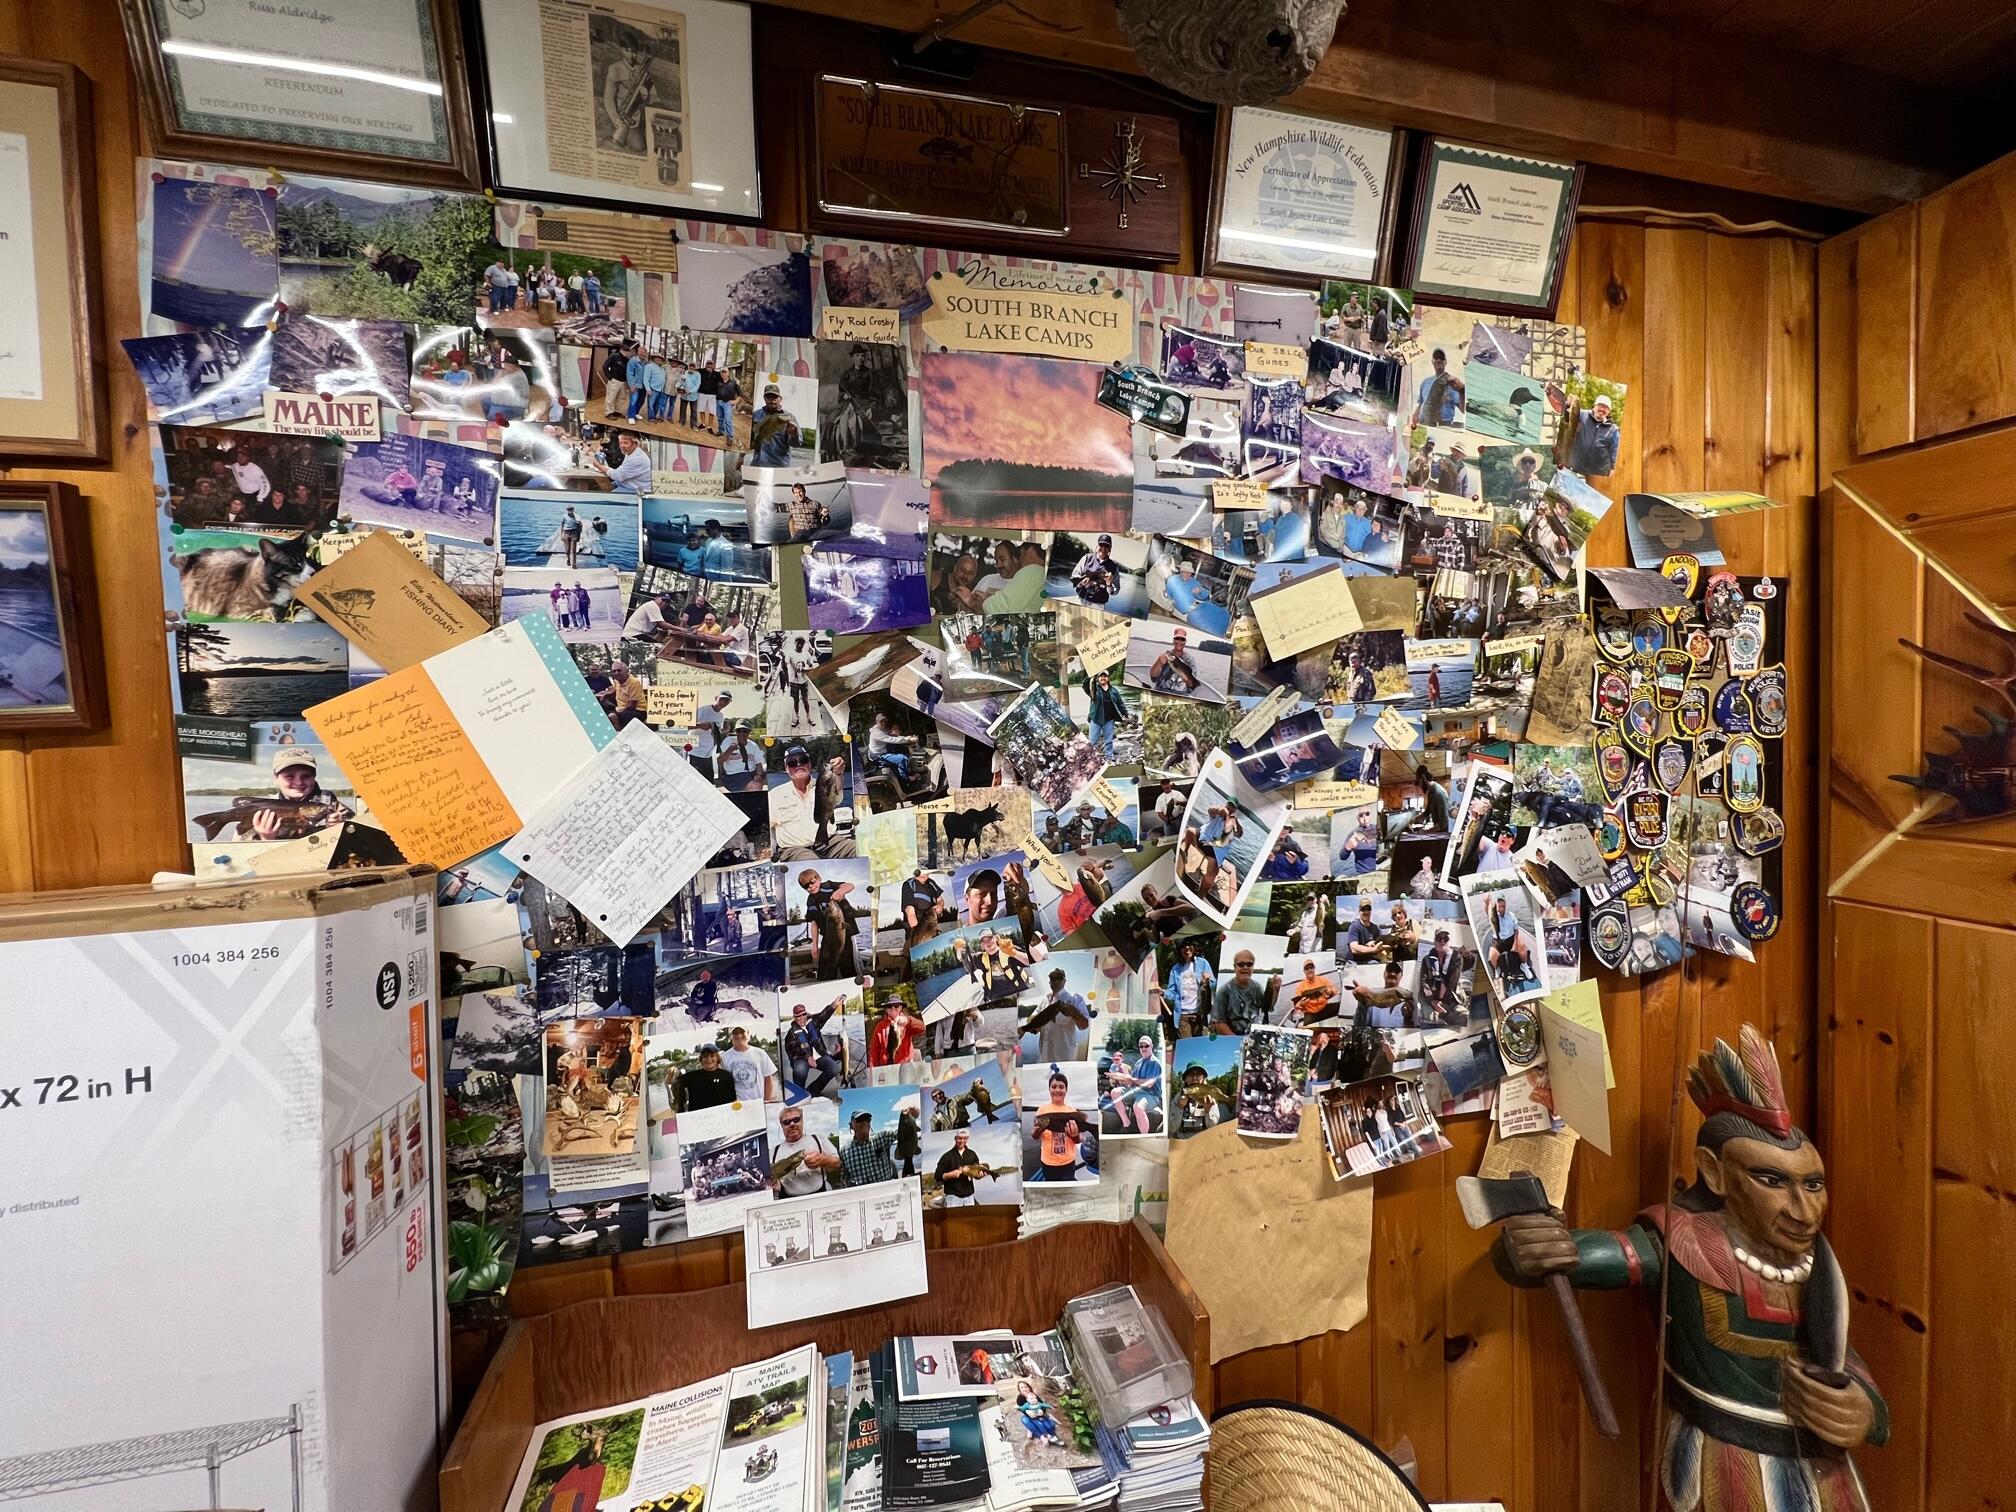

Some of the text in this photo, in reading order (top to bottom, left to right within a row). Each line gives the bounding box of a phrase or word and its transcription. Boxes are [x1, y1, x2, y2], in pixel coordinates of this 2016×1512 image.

[1235, 130, 1379, 198] New Hampshire Wildlife Federation
[1263, 165, 1357, 187] Certificate of Appreciation
[961, 259, 1105, 296] Memories
[947, 295, 1118, 329] SOUTH BRANCH
[829, 315, 895, 332] Fly Rod Crosby
[844, 331, 873, 342] Maine
[965, 322, 1093, 350] LAKE CAMPS
[1117, 380, 1160, 401] South Branch
[1119, 391, 1132, 401] Lake
[1133, 396, 1155, 409] Camps
[273, 399, 374, 428] MAINE
[274, 424, 376, 437] The way life should be.
[322, 537, 355, 548] Keeping
[1669, 556, 1697, 568] ANDOVER
[400, 585, 457, 636] FISHING DIARY
[1079, 631, 1121, 655] We practice
[1091, 641, 1121, 660] catch and
[1756, 678, 1778, 692] POLICE
[664, 710, 693, 721] counting
[177, 727, 247, 738] SAVE MOOSEHEAD
[1634, 802, 1658, 816] OXFORD
[1640, 821, 1660, 833] POLICE
[1025, 836, 1041, 854] What
[1610, 877, 1632, 893] VIETNAM
[172, 946, 280, 967] 1004 384 256
[325, 927, 334, 1009] 1004 384 256
[383, 971, 395, 1004] NSF
[413, 1053, 423, 1069] 5
[0, 1066, 152, 1109] x 72 in H
[10, 1195, 79, 1214] distributed
[406, 1224, 417, 1273] 650
[746, 1366, 797, 1387] ATV TRAILS
[759, 1361, 786, 1375] MAINE
[761, 1380, 781, 1390] MAP
[651, 1401, 678, 1413] MAINE
[679, 1386, 723, 1406] COLLISIONS
[647, 1413, 706, 1436] crashes happen
[649, 1420, 656, 1428] In
[686, 1403, 713, 1416] wildlife
